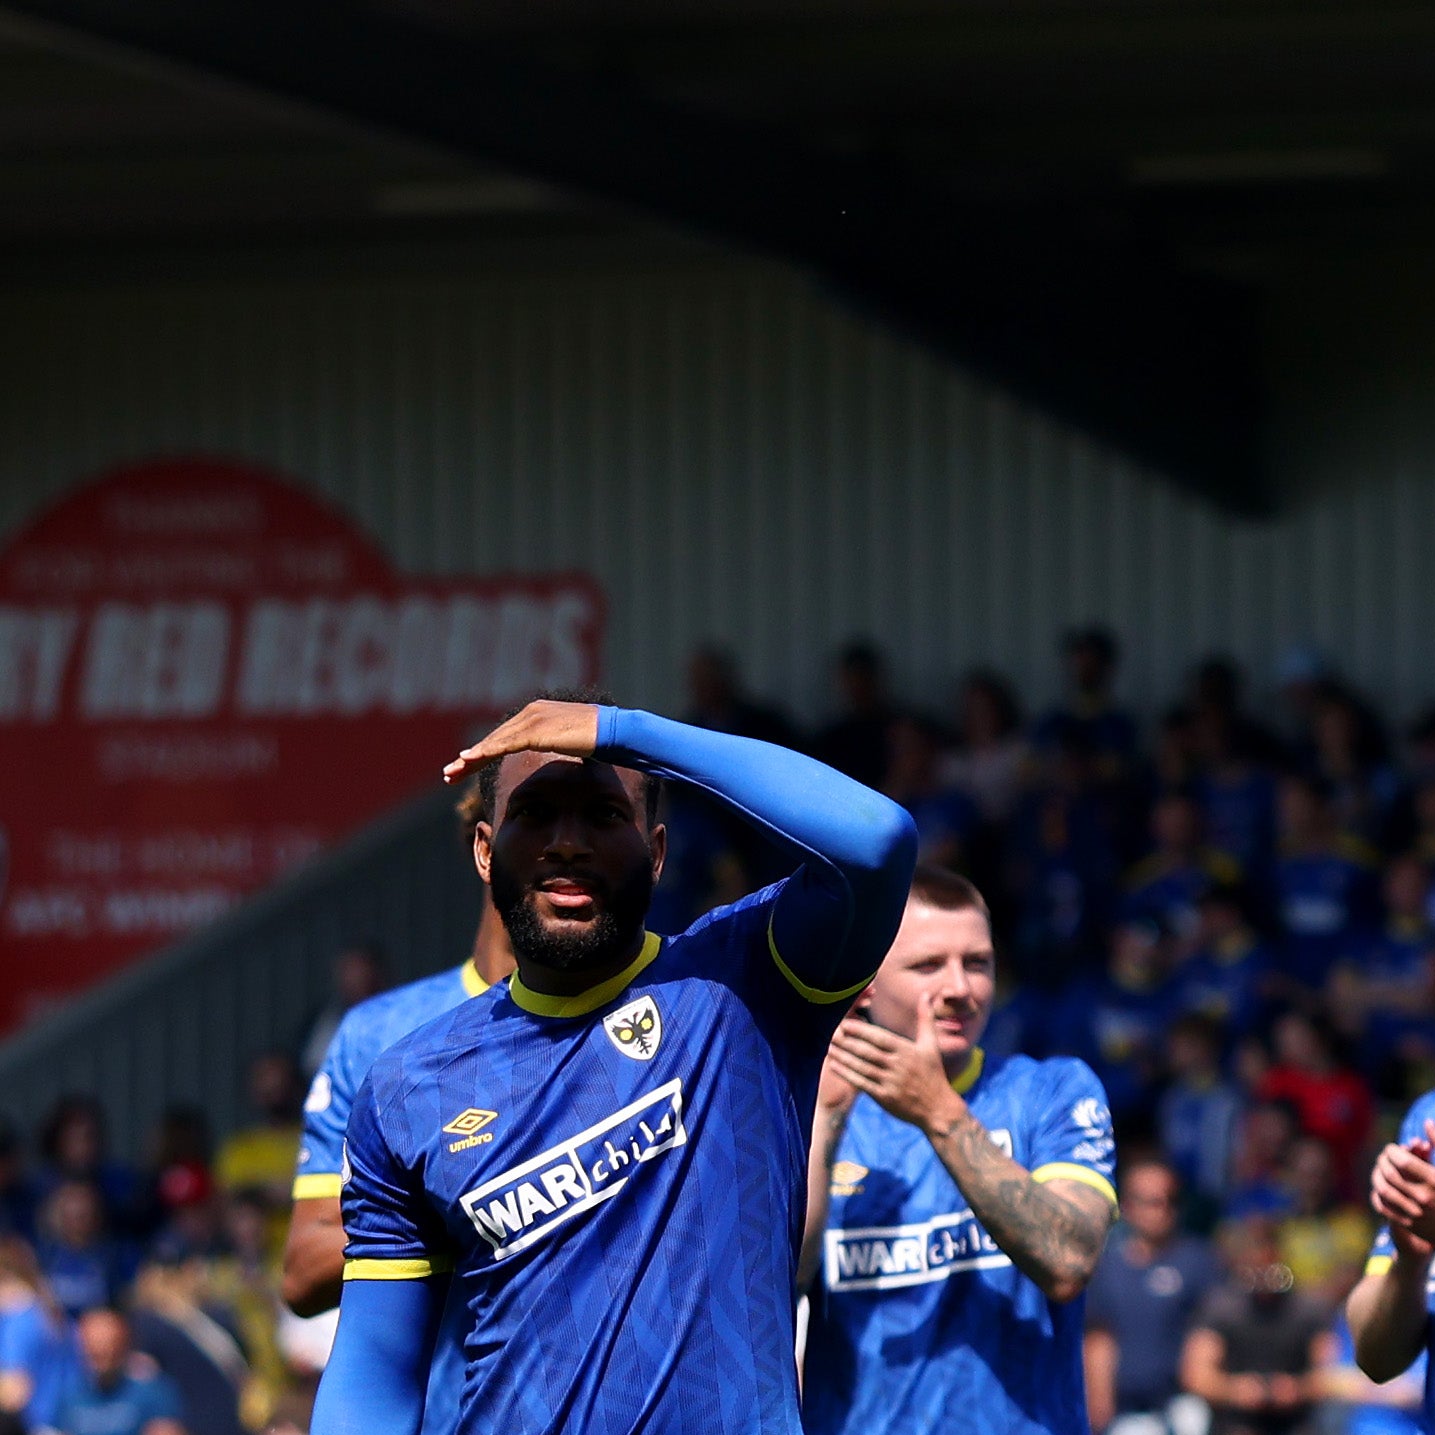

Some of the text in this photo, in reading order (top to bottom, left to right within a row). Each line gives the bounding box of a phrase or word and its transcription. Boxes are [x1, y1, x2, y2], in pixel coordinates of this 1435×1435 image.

[80, 599, 231, 719] RED
[237, 590, 590, 715] RECORDS
[449, 1131, 493, 1153] umbro
[475, 1163, 587, 1239] WAR
[837, 1238, 922, 1277] WAR
